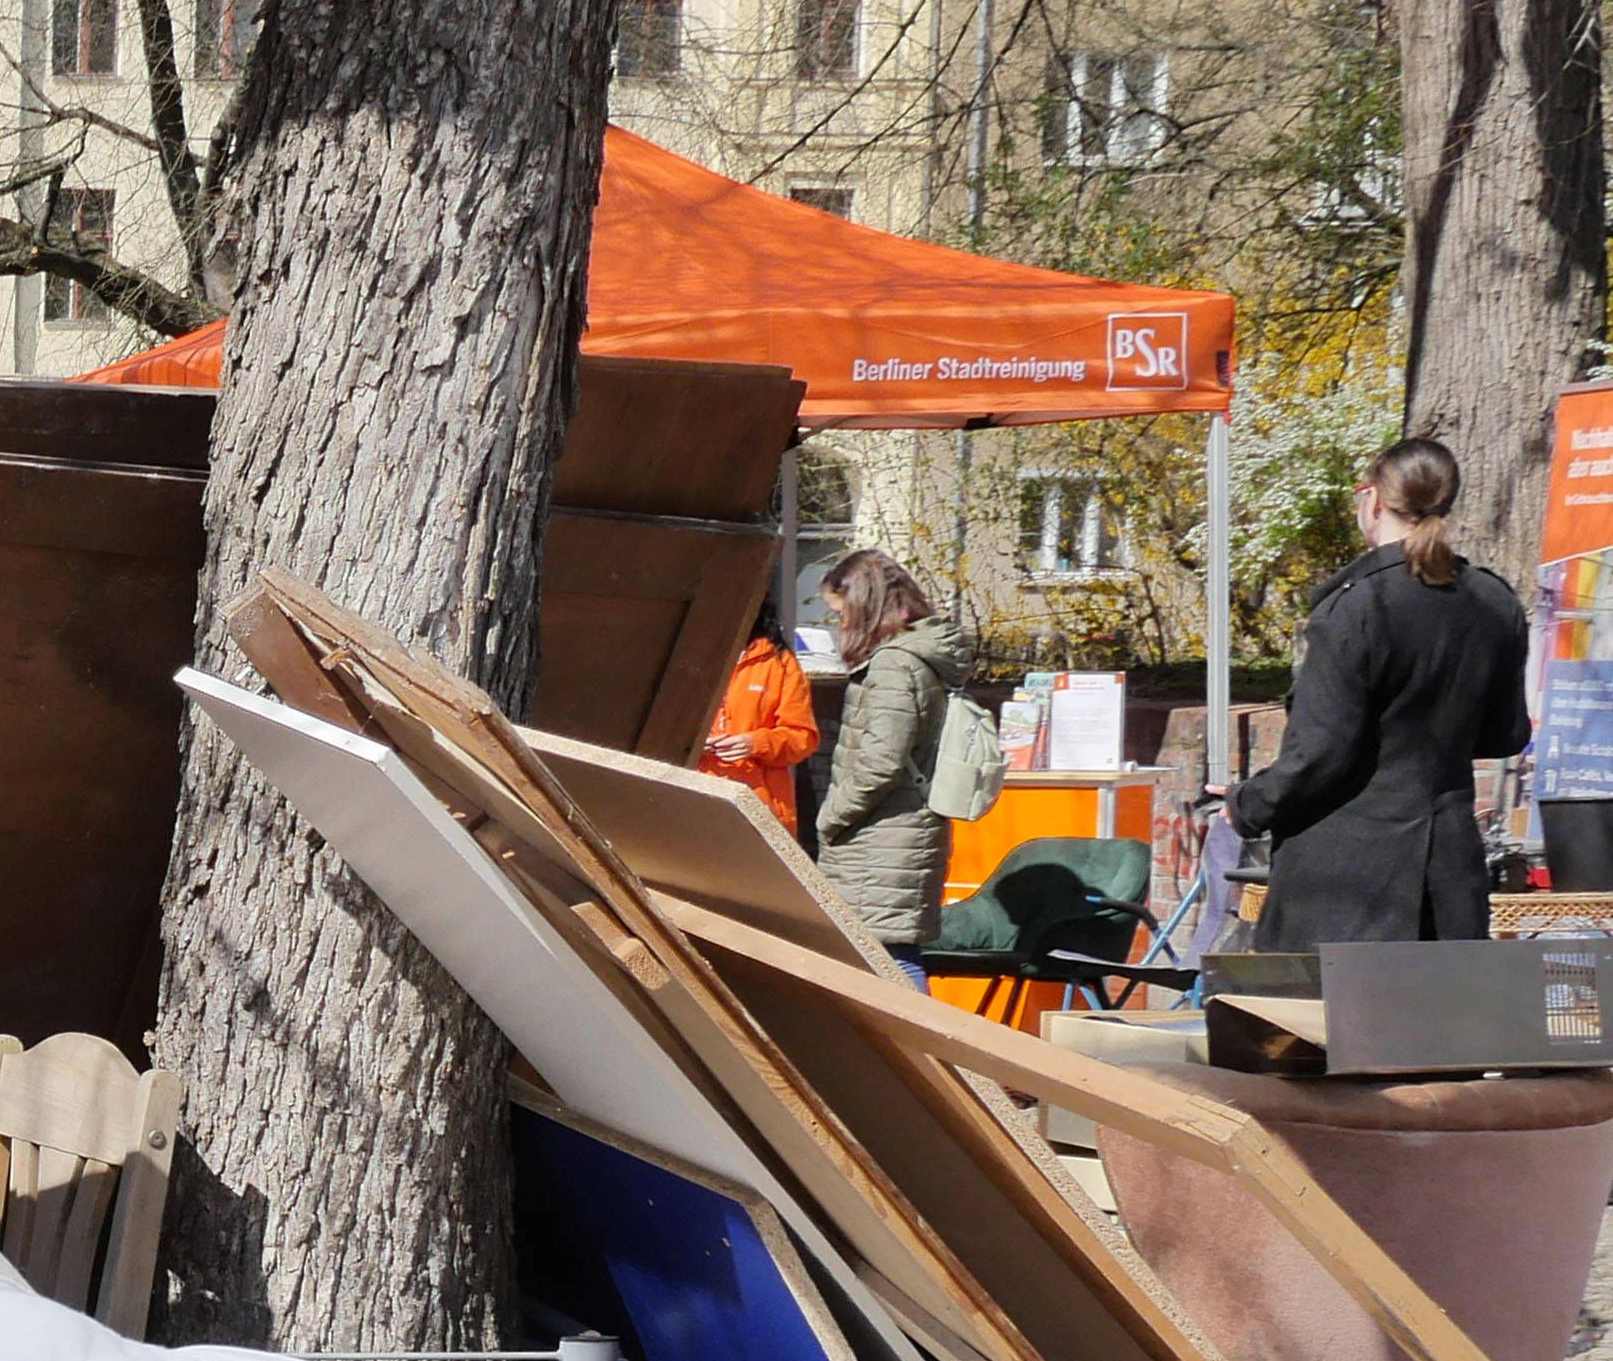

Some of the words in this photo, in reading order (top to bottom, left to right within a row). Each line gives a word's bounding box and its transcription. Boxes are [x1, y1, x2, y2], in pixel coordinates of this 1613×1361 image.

[852, 358, 932, 381] Berliner
[936, 357, 1086, 383] Stadtreinigung
[1114, 328, 1178, 378] BSR
